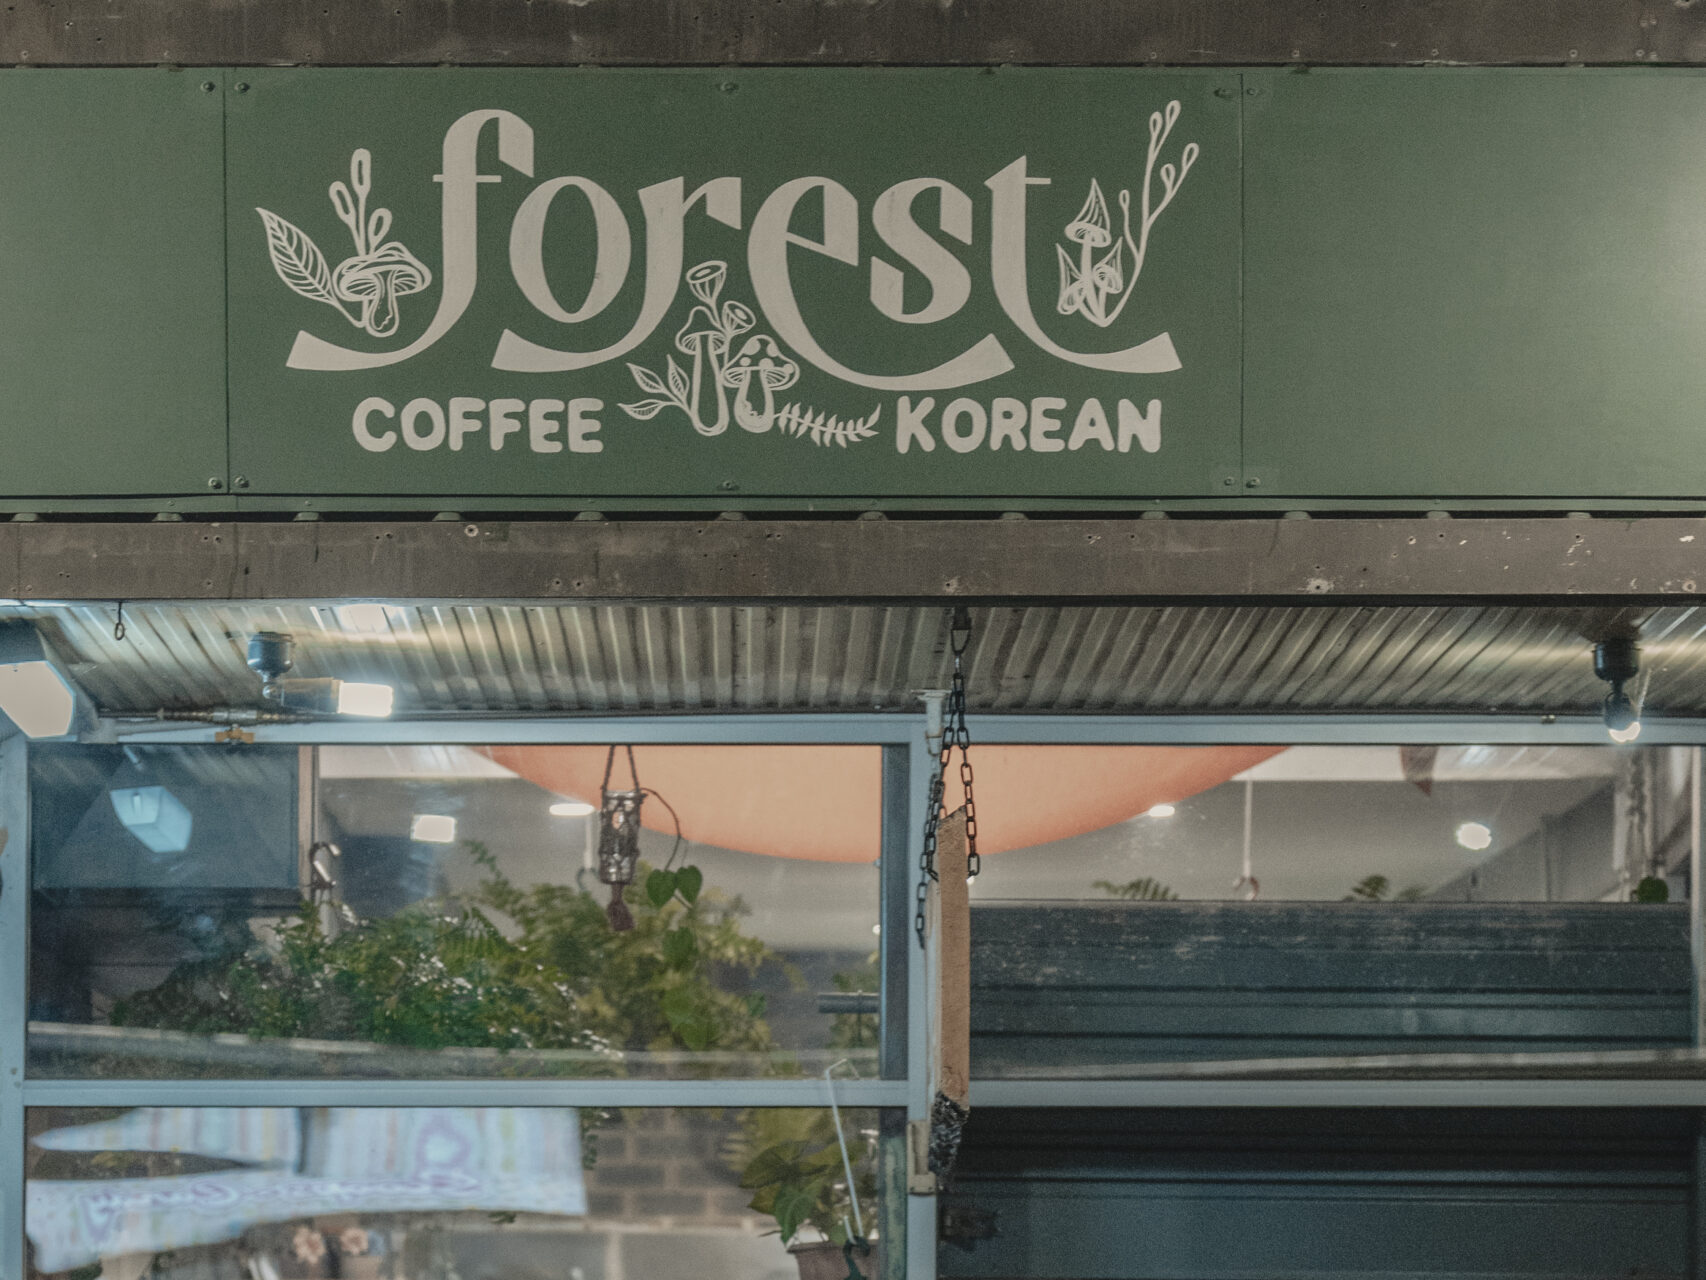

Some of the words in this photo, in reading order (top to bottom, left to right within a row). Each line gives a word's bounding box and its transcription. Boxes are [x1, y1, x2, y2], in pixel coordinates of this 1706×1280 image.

[286, 109, 1183, 391] forest
[352, 396, 604, 454] COFFEE
[896, 396, 1162, 454] KOREAN
